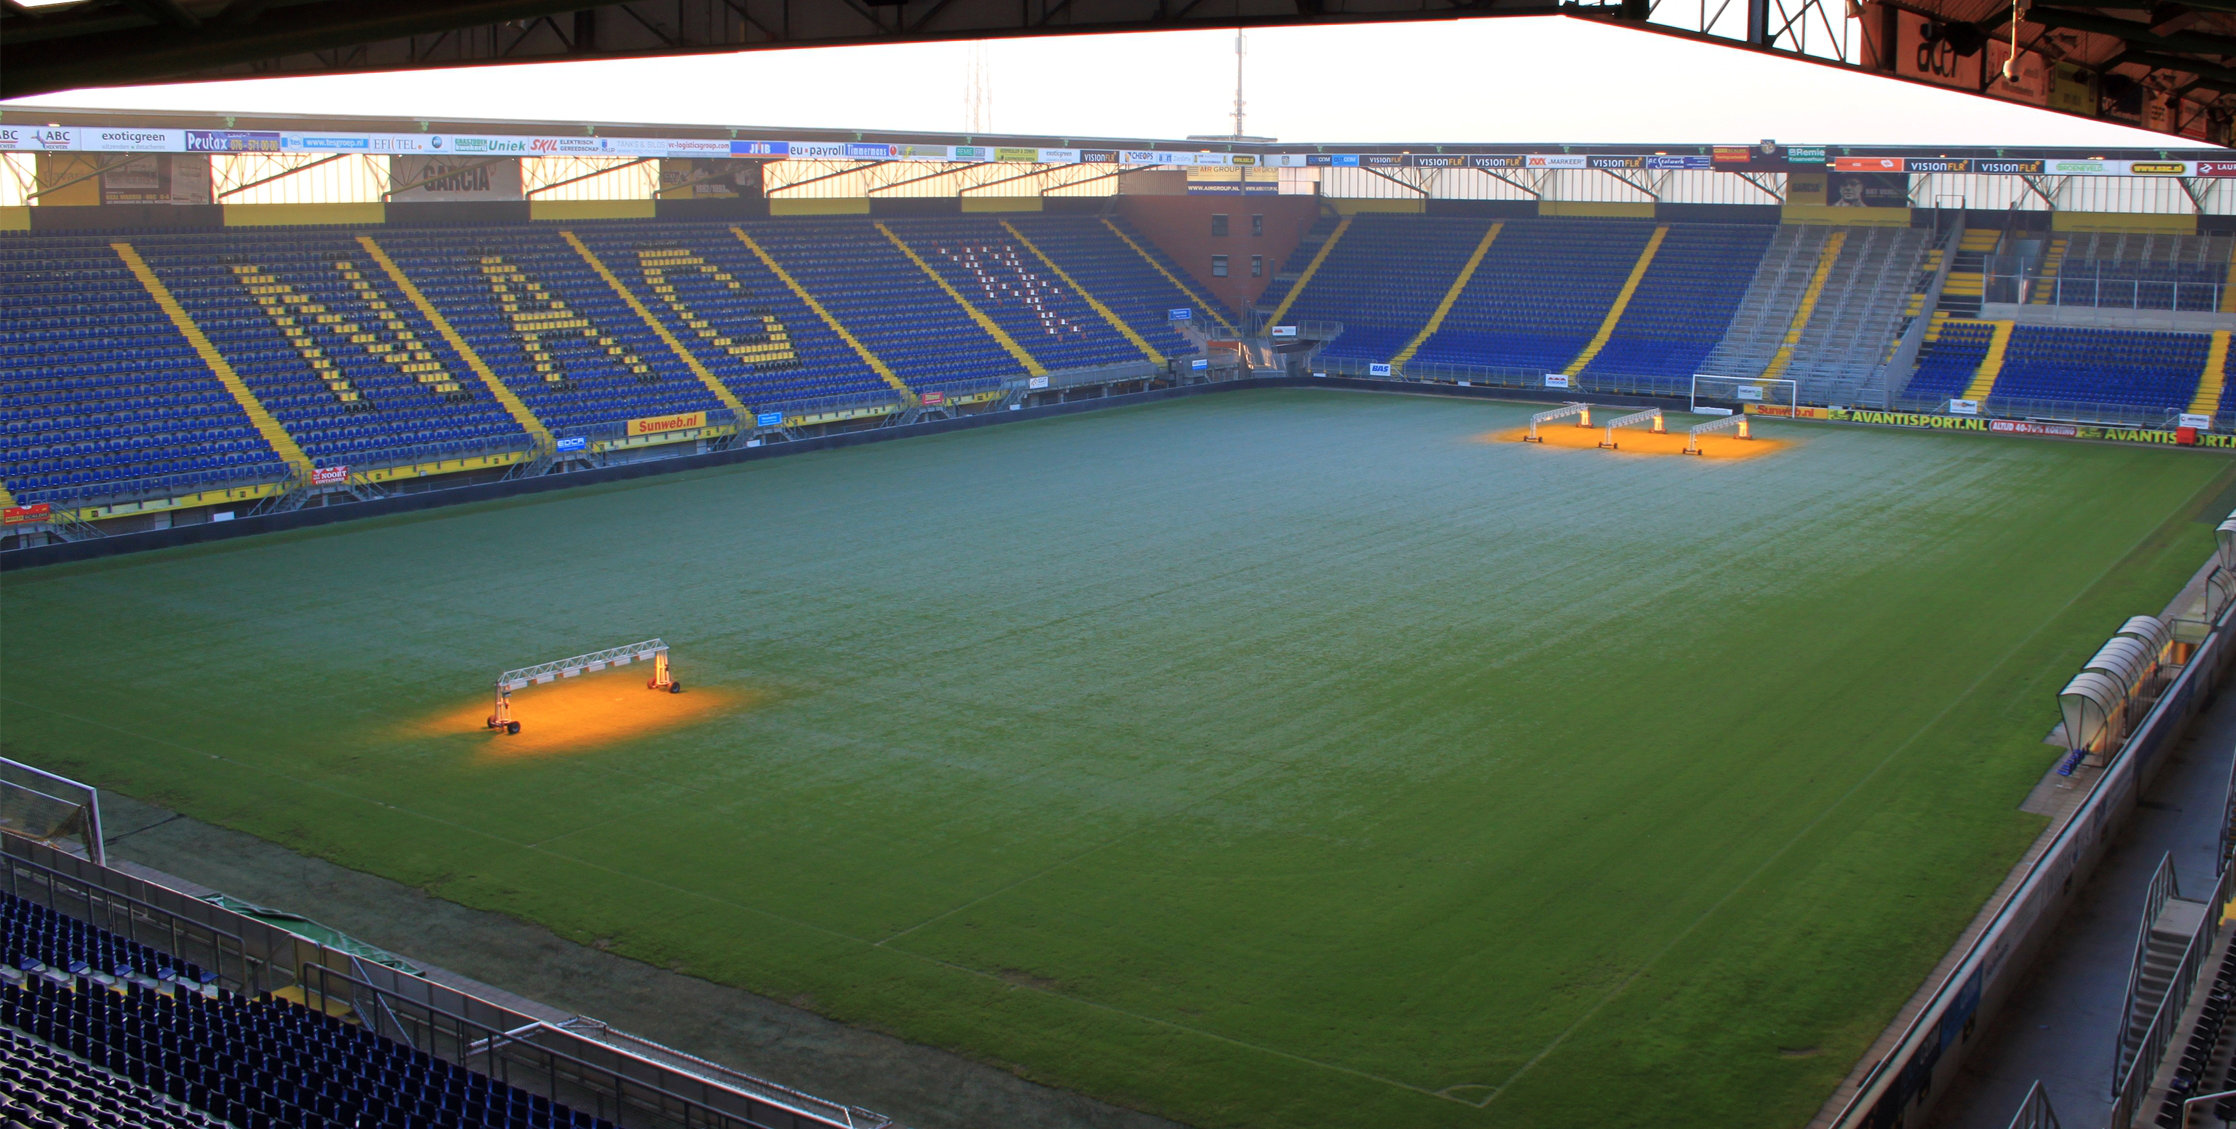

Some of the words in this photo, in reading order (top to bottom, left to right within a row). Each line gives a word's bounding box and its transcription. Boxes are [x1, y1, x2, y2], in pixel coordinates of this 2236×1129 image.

[0, 130, 19, 140] BC
[46, 131, 71, 140] ABC
[102, 131, 166, 143] exoticgreen
[187, 132, 228, 150] Peutax
[489, 140, 526, 152] Uniek
[530, 139, 558, 153] SKIL
[1131, 152, 1154, 161] CHEOPS
[1419, 158, 1463, 166] VISIONFLR
[1475, 158, 1520, 166] VISIONFLR
[1593, 159, 1640, 167] VISIONFLR
[1911, 162, 1966, 171] VISIONFLR
[1982, 163, 2038, 172] VISIONFLR
[423, 165, 490, 192] GARCIA
[639, 415, 697, 433] Sunweb.nl
[1852, 411, 1988, 431] AVANTISPORT.NL
